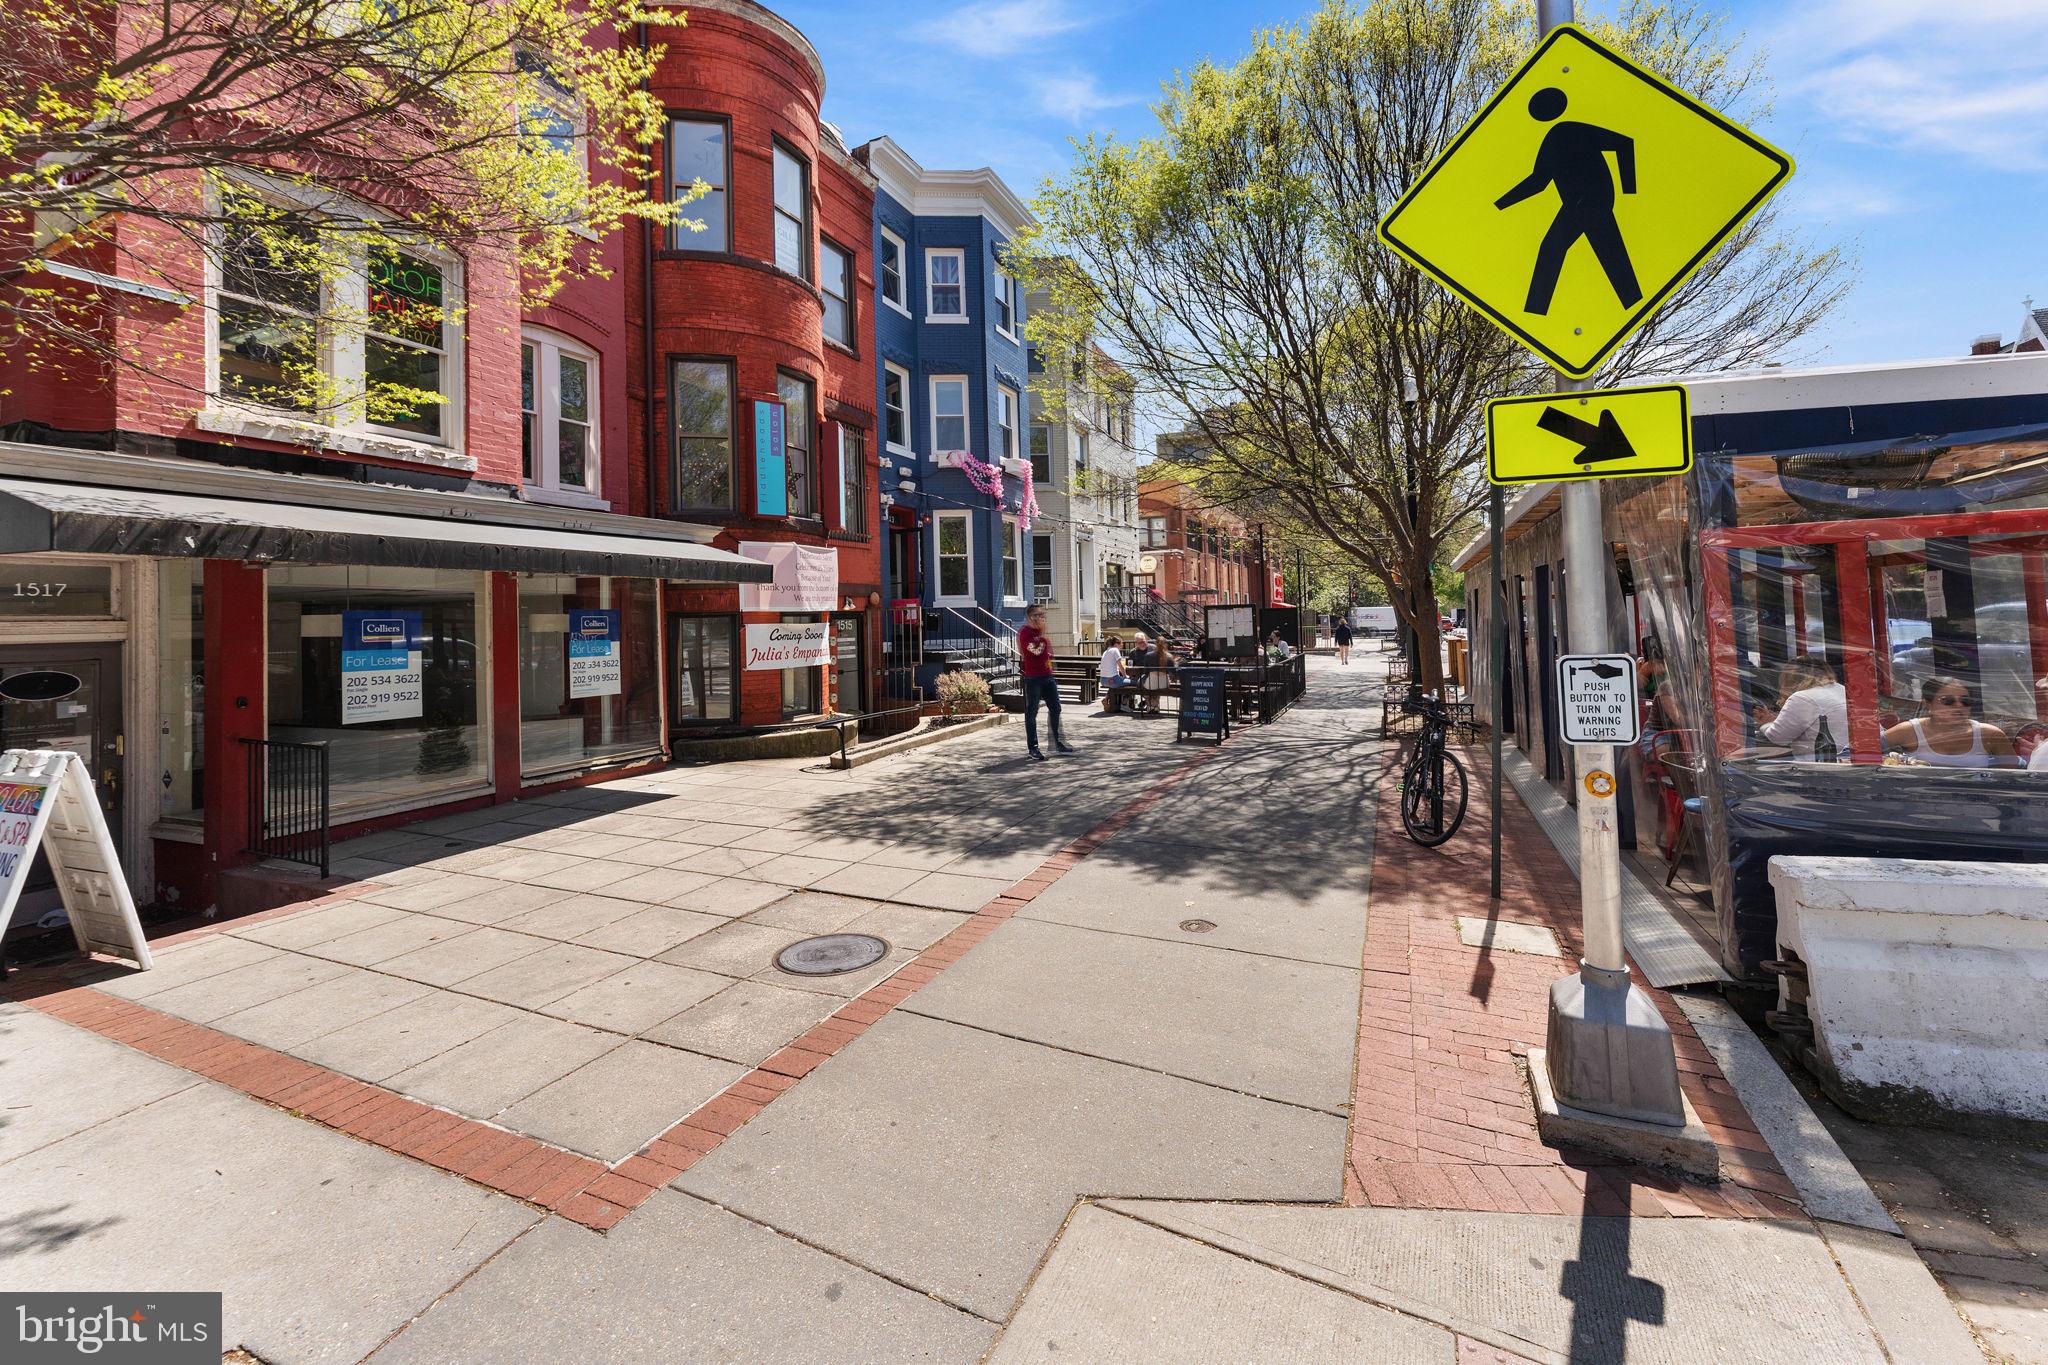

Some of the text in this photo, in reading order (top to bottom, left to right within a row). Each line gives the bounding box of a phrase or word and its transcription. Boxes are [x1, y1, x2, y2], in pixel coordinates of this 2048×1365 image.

[13, 583, 67, 597] 1517
[756, 583, 780, 591] Thank
[780, 585, 796, 593] you
[794, 595, 804, 603] We
[366, 623, 401, 633] Colliers
[837, 619, 853, 630] 1515
[769, 628, 803, 644] Coming
[571, 643, 610, 654] For Lease
[345, 655, 405, 668] For Lease
[747, 645, 789, 667] Julia's
[572, 661, 586, 670] 202
[601, 659, 619, 668] 3622
[346, 673, 421, 688] 202 534 3622
[572, 672, 619, 684] 202 919 9522
[1584, 682, 1610, 691] PUSH
[347, 690, 420, 706] 202 919 9522
[1569, 693, 1626, 703] BUTTON TO
[1576, 705, 1622, 713] TURN ON
[1577, 716, 1621, 725] WARNING
[1583, 728, 1617, 736] LIGHTS
[8, 821, 32, 847] SPA
